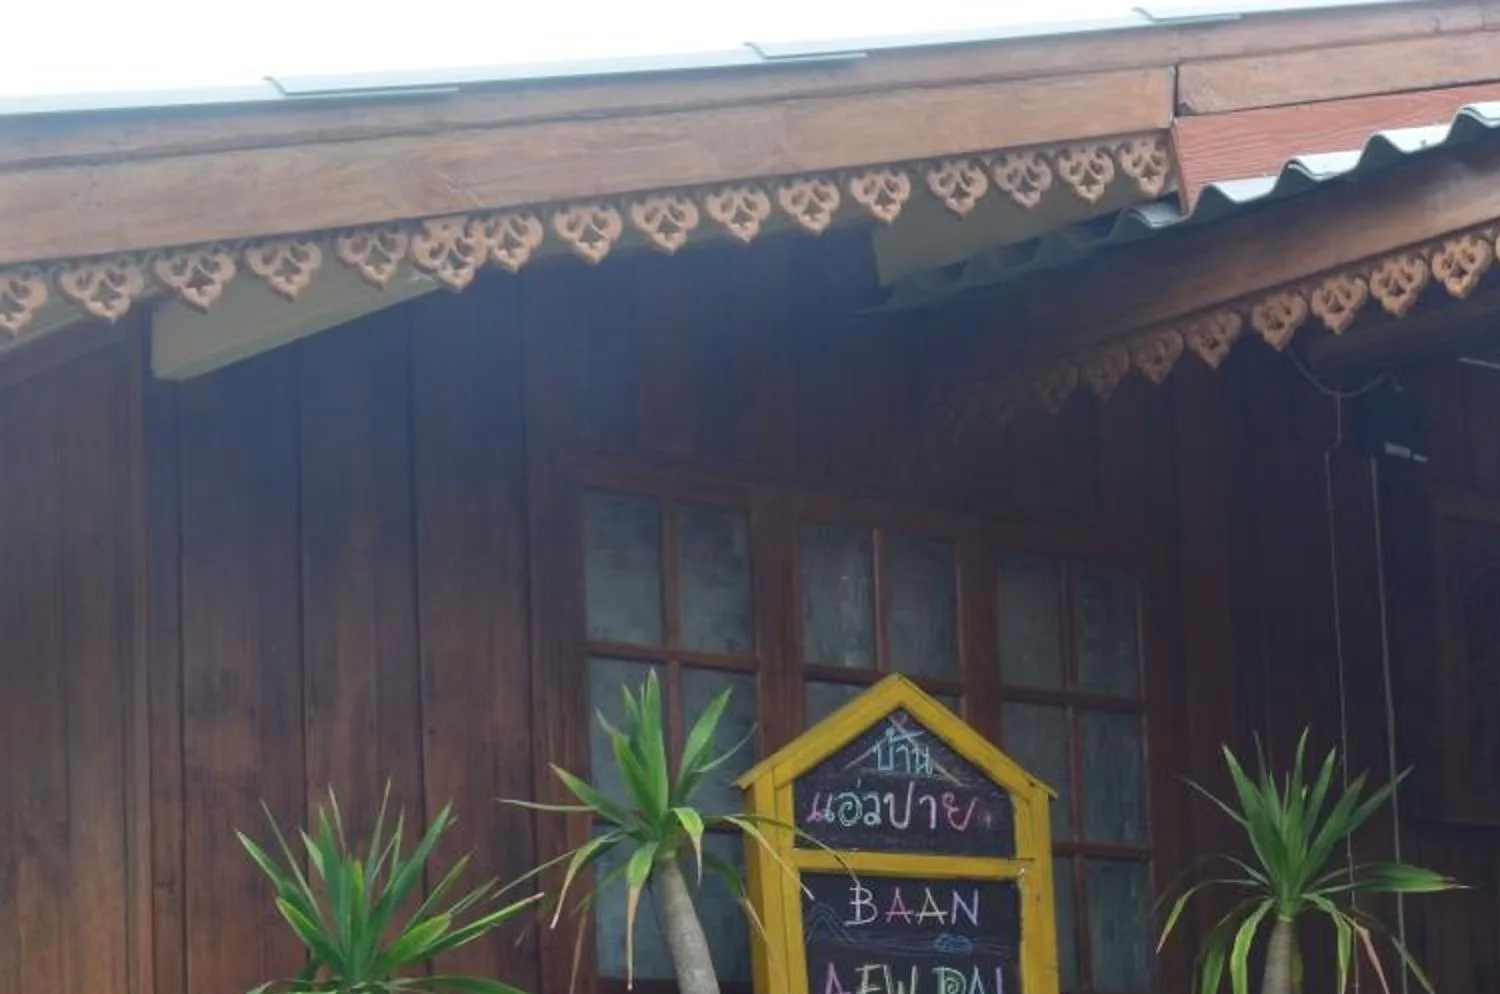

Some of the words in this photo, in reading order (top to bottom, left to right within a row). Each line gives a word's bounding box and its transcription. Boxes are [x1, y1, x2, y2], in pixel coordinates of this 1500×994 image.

[872, 726, 934, 776] บ้าน
[806, 777, 978, 831] แอ่วปาย
[844, 886, 980, 926] BAAN
